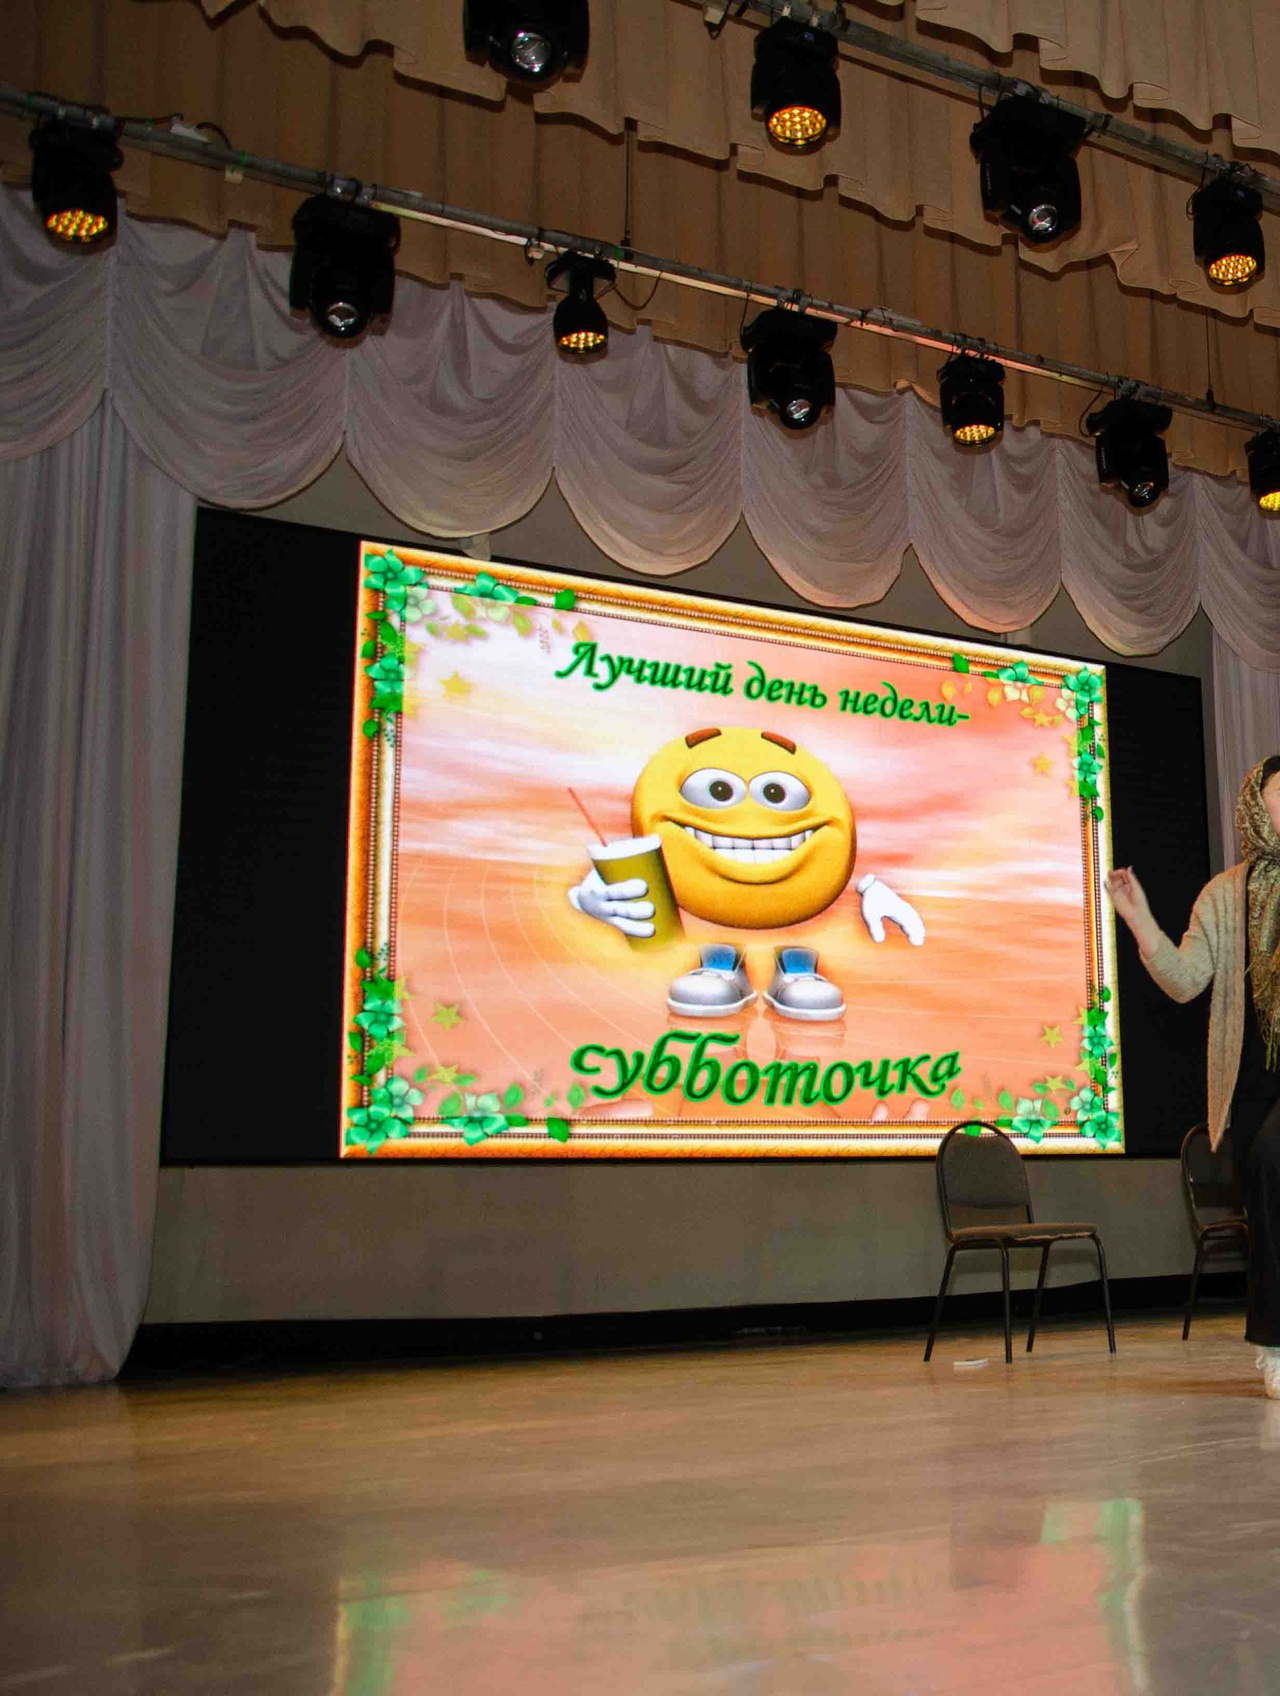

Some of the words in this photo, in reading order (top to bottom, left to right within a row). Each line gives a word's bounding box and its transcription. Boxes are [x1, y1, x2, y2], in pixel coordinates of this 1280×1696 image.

[555, 641, 734, 696] Лучший
[743, 660, 828, 709] день
[838, 682, 970, 727] недели-
